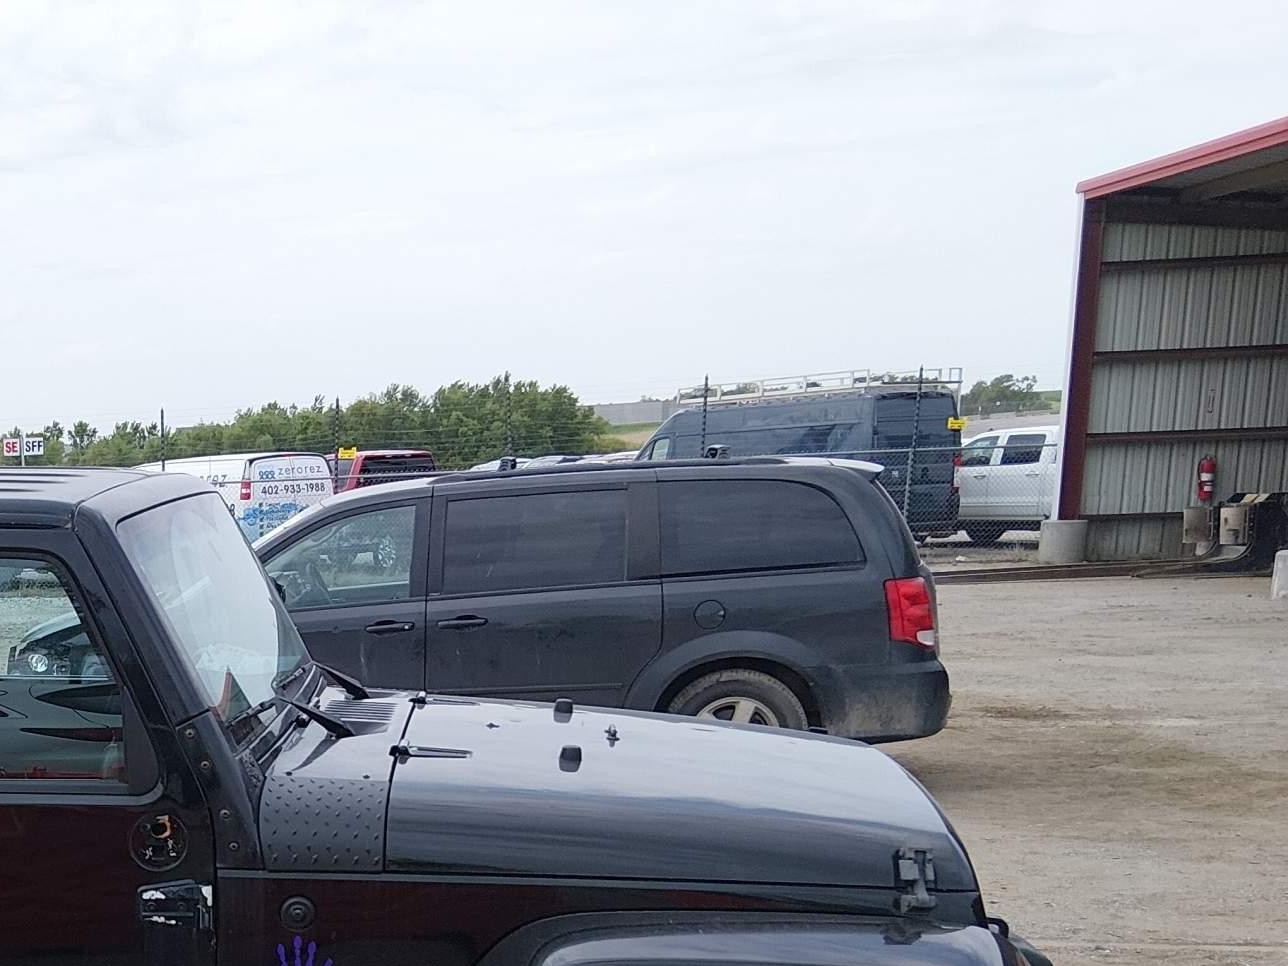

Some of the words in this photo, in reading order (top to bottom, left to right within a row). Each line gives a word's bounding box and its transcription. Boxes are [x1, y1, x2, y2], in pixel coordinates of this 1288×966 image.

[5, 441, 18, 453] SE
[25, 440, 43, 453] SFF
[278, 466, 323, 476] zerorez
[261, 482, 325, 495] 402-933-1988
